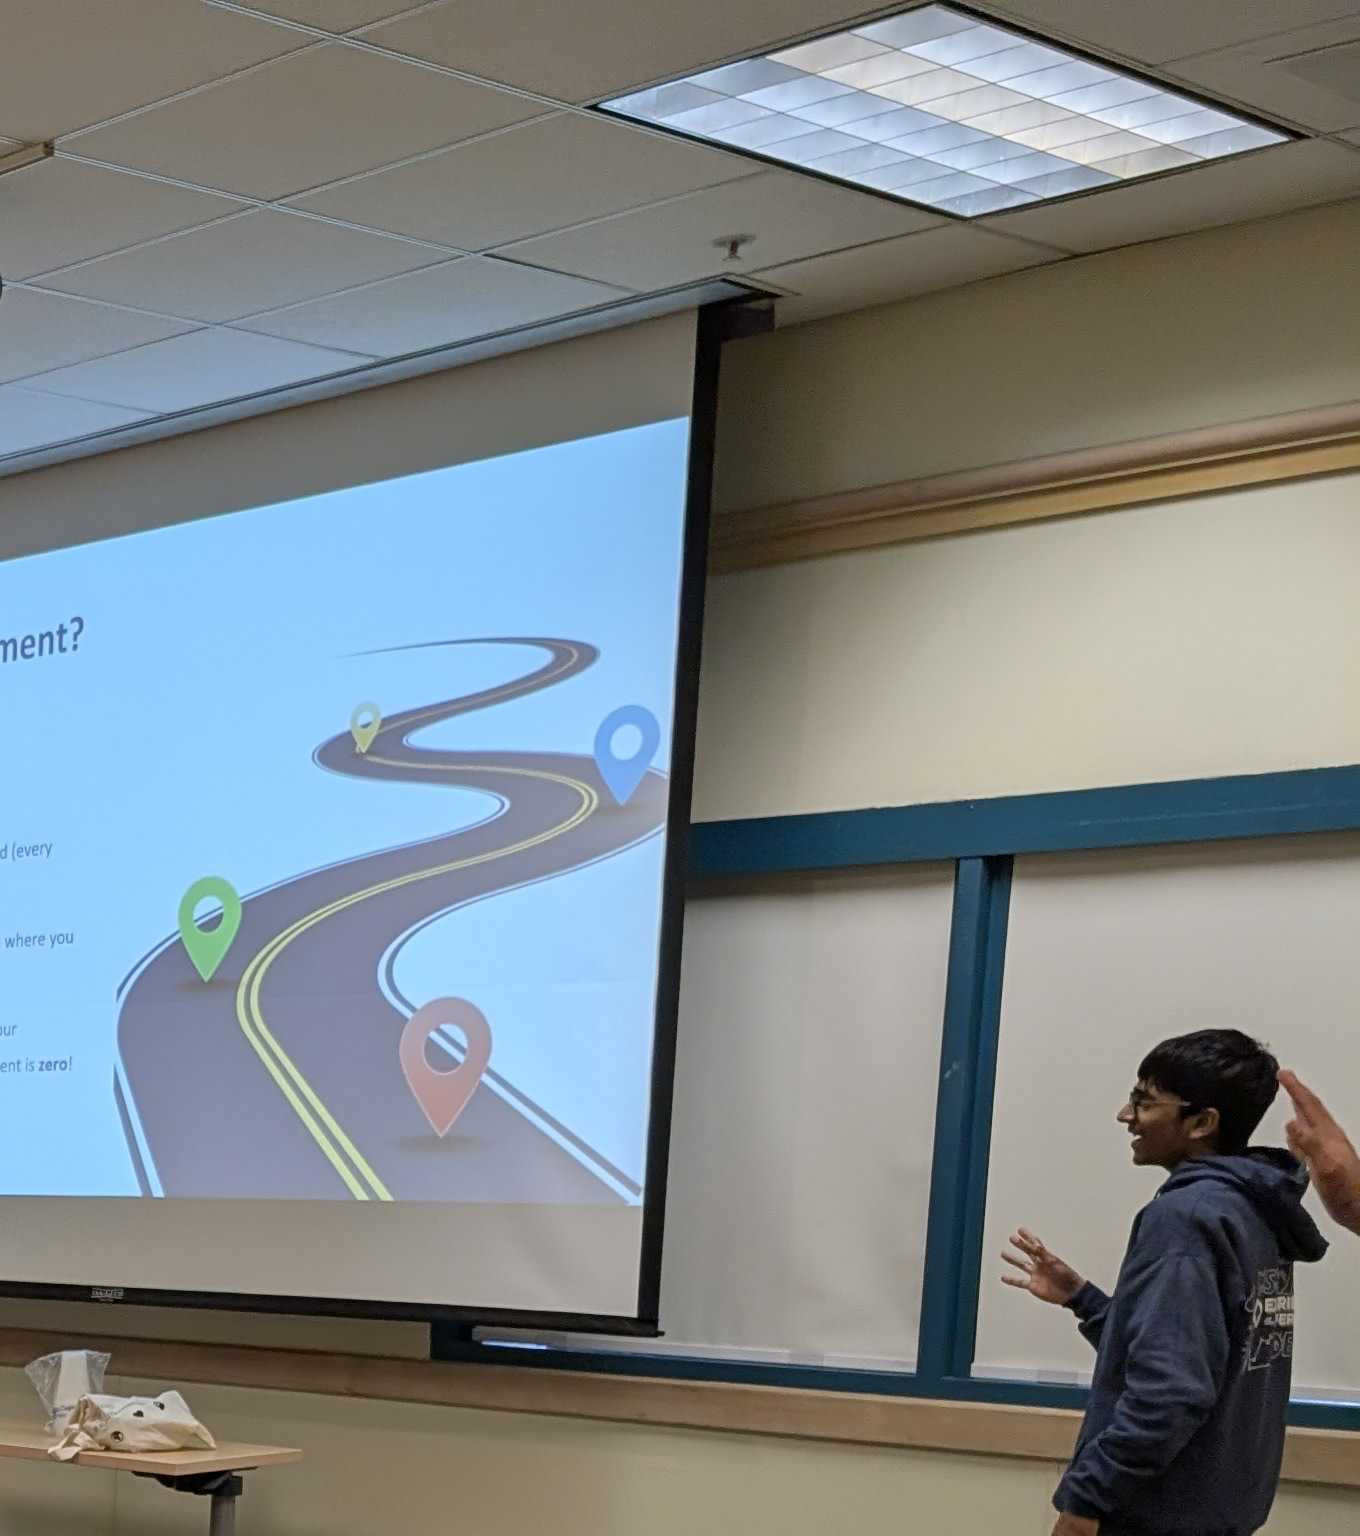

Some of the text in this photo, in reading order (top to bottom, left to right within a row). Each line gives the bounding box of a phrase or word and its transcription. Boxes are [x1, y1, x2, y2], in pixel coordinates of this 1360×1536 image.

[12, 841, 53, 862] (every
[4, 932, 45, 948] where
[49, 932, 73, 948] you
[25, 1058, 35, 1072] is
[38, 1056, 72, 1072] zero!
